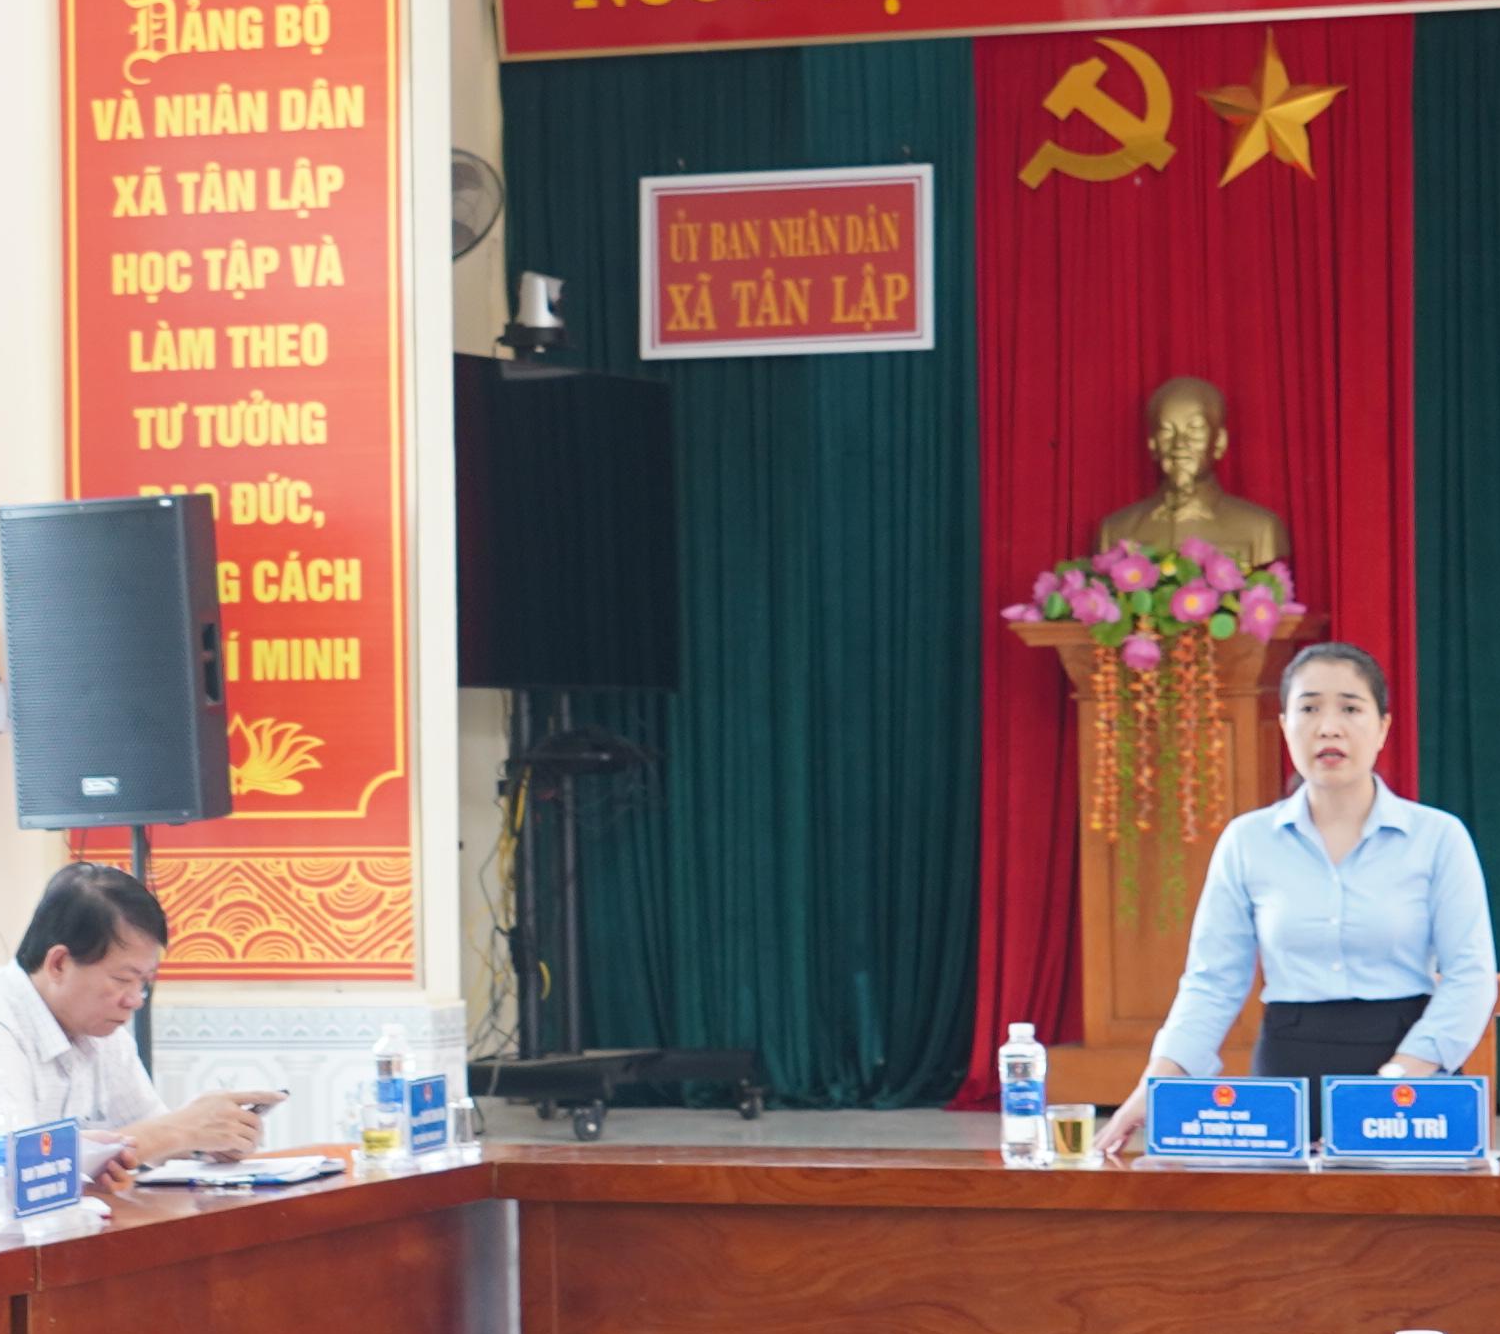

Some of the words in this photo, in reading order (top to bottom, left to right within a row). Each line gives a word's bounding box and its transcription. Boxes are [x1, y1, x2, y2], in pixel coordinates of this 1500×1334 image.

[91, 89, 145, 141] VÀ
[155, 83, 269, 138] NHÂN
[279, 78, 365, 132] DÂN
[113, 165, 168, 218] XÃ
[177, 162, 257, 215] TÂN
[267, 157, 345, 219] LẬP
[669, 209, 701, 264] ỦY
[710, 219, 762, 261] BAN
[770, 208, 841, 258] NHÂN
[846, 204, 900, 255] DÂN
[112, 249, 193, 305] HỌC
[202, 238, 280, 300] TẬP
[290, 233, 345, 288] VÀ
[666, 272, 718, 332] XÃ
[731, 267, 812, 329] TÂN
[831, 262, 911, 332] LẬP
[130, 320, 216, 372] LÀM
[226, 322, 328, 369] THEO
[133, 401, 189, 450] TƯ
[193, 389, 328, 448] TƯỞNG
[230, 472, 326, 528] ĐỨC,
[252, 550, 362, 604] CÁCH
[252, 637, 361, 682] MINH
[1362, 1112, 1409, 1140] CHỦ
[1411, 1113, 1448, 1140] TRÌ
